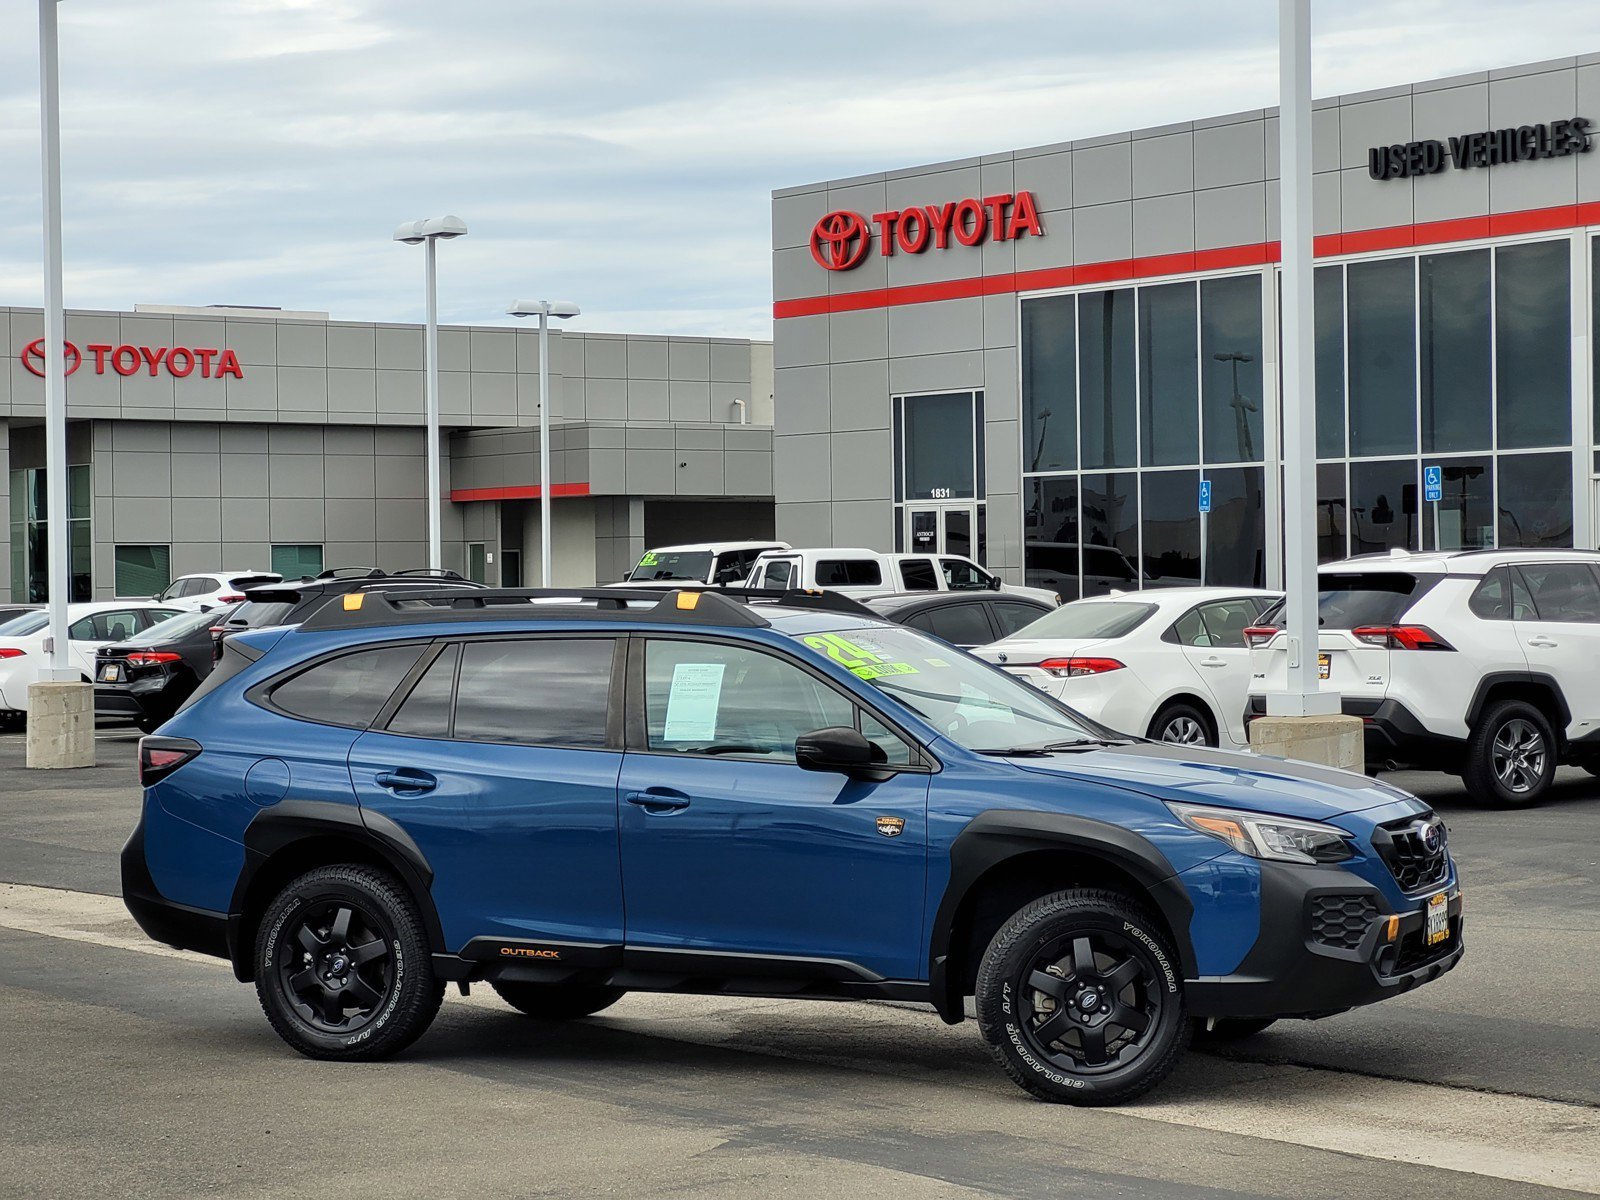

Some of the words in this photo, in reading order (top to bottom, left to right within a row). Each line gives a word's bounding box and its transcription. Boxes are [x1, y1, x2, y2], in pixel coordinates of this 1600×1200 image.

[1368, 140, 1445, 180] USED
[1448, 117, 1592, 170] VEHICLES
[872, 191, 1043, 257] TOYOTA
[87, 344, 244, 379] TOYOTA
[930, 488, 950, 498] 1831
[1428, 491, 1439, 499] ONLY
[803, 633, 885, 668] 24
[264, 898, 301, 968] YOKOHAMA
[500, 947, 560, 958] OUTBACK
[1123, 921, 1177, 993] YOKOHAMA
[376, 939, 404, 1028] GEOLANDAR
[1002, 982, 1011, 1015] A/T
[347, 1029, 371, 1045] A/T
[1005, 1022, 1085, 1089] GEOLANDAR
